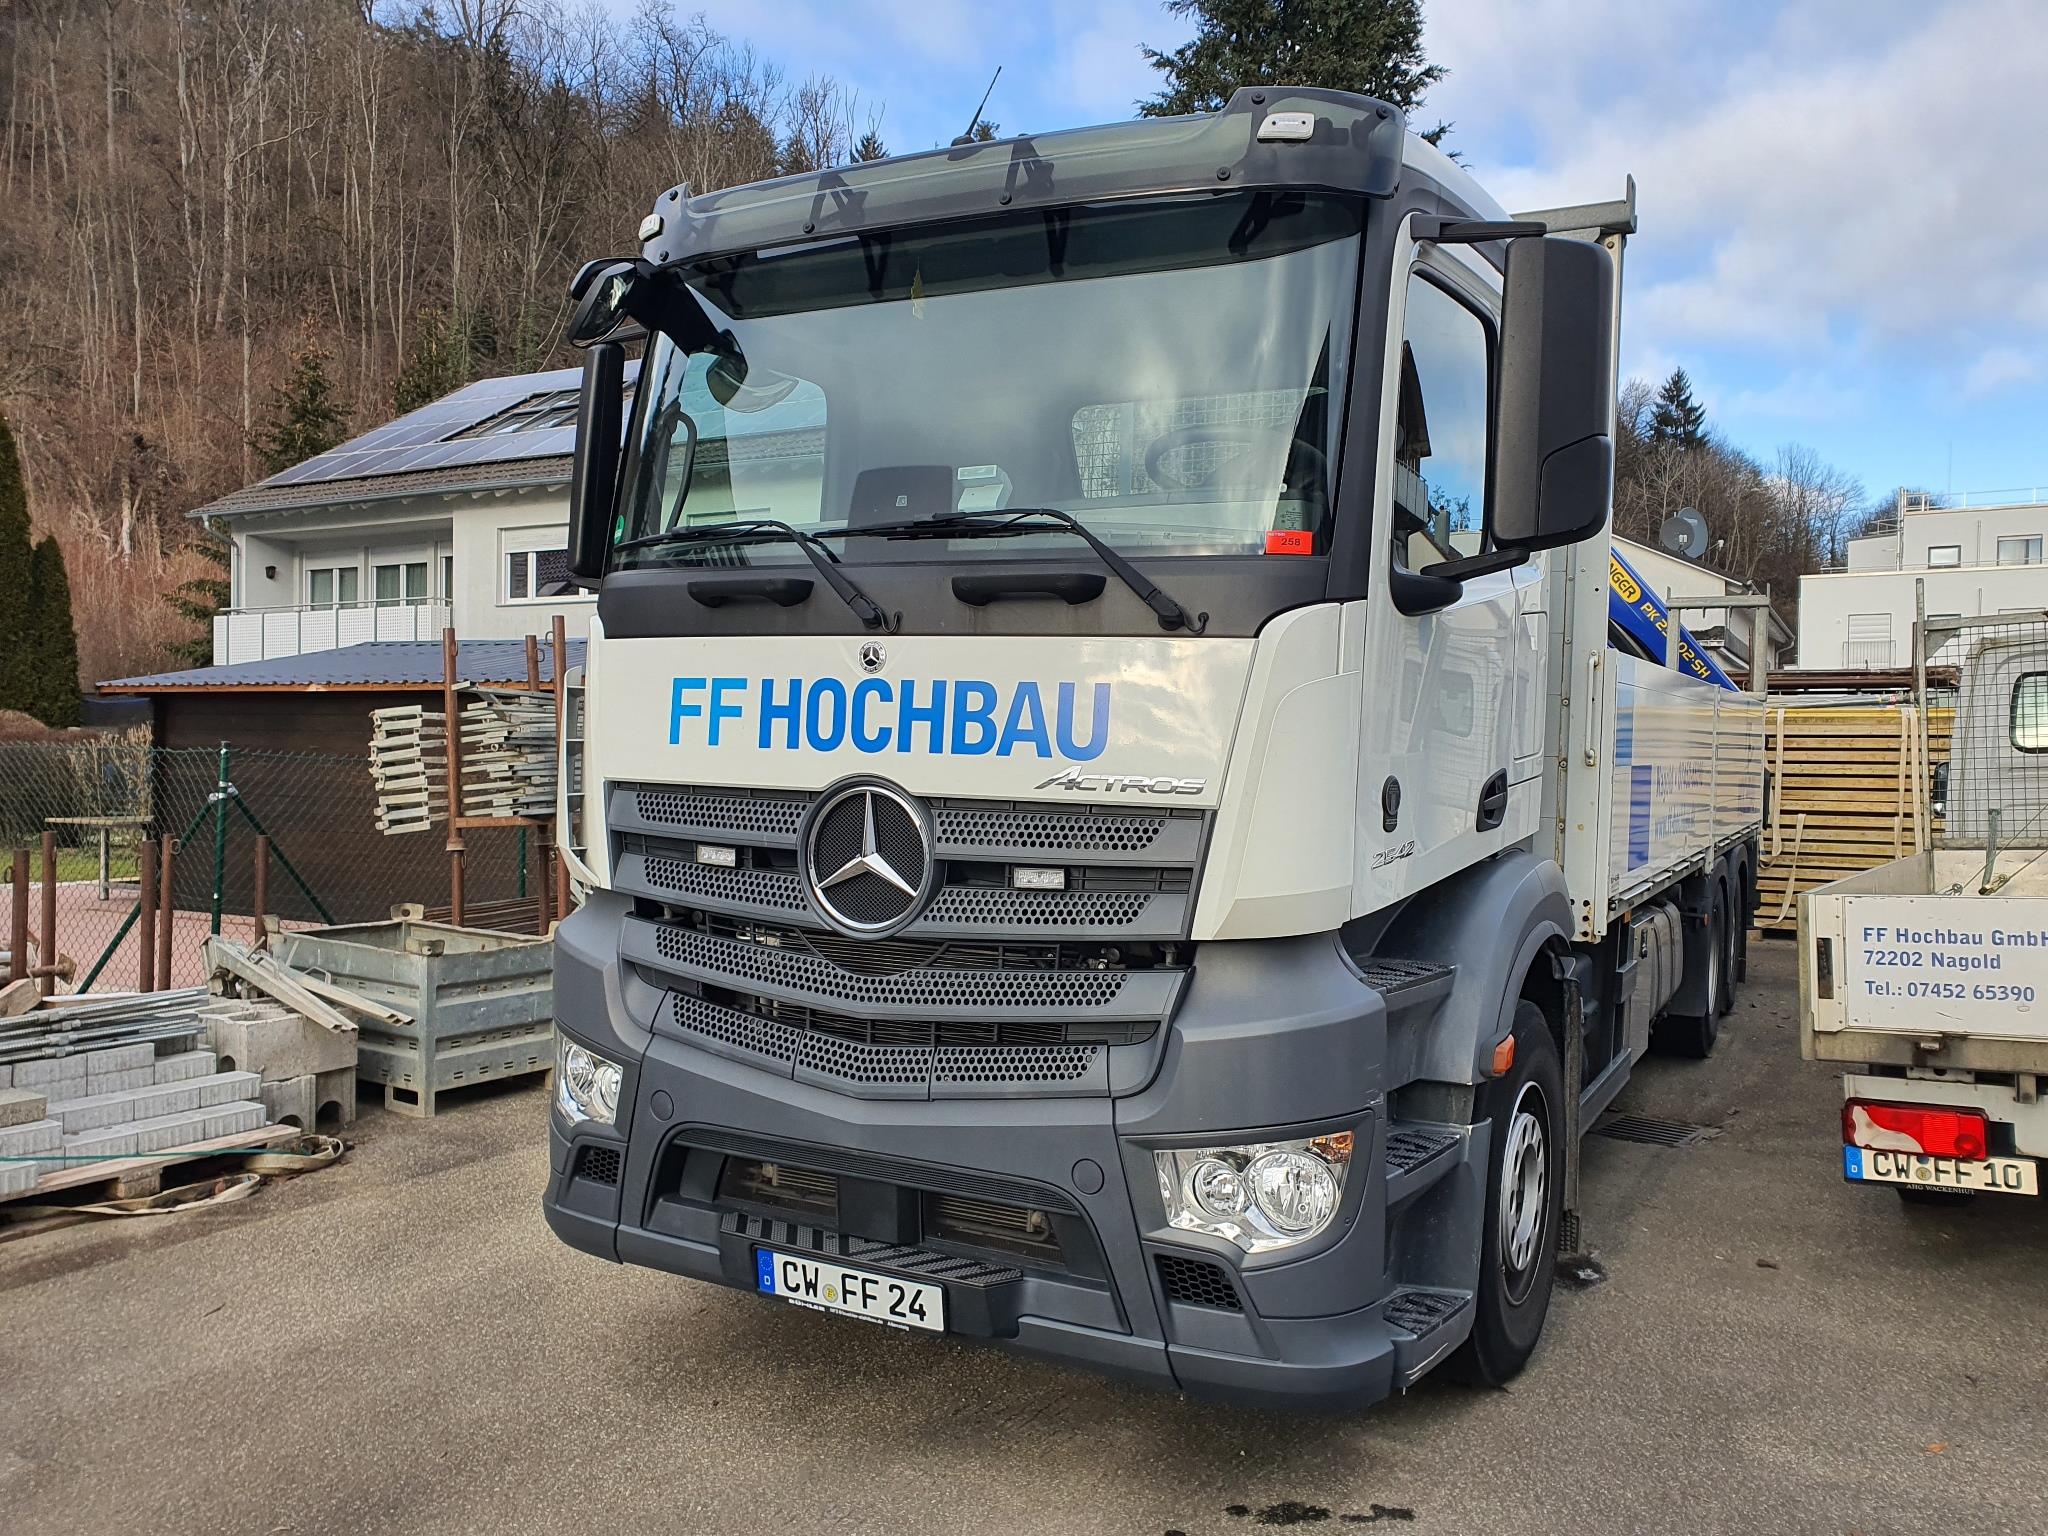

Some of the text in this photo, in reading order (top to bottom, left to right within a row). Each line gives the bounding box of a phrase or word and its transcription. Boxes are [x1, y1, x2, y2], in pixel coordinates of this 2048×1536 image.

[1281, 538, 1301, 546] 258
[1640, 602, 1660, 621] PK
[669, 677, 1112, 762] FF HOCHBAU
[1033, 765, 1207, 795] ACTROS
[1863, 927, 2048, 946] FF Hochbau GmbH
[1864, 950, 2001, 971] 72202 Nagold
[1865, 981, 2035, 1002] Tel.: 07452 65390
[1873, 1152, 1911, 1179] CW
[1934, 1158, 1974, 1185] FF
[1983, 1162, 2022, 1190] 10
[764, 1275, 771, 1285] D
[783, 1261, 819, 1298] CW
[841, 1273, 879, 1309] FF
[889, 1284, 927, 1321] 24
